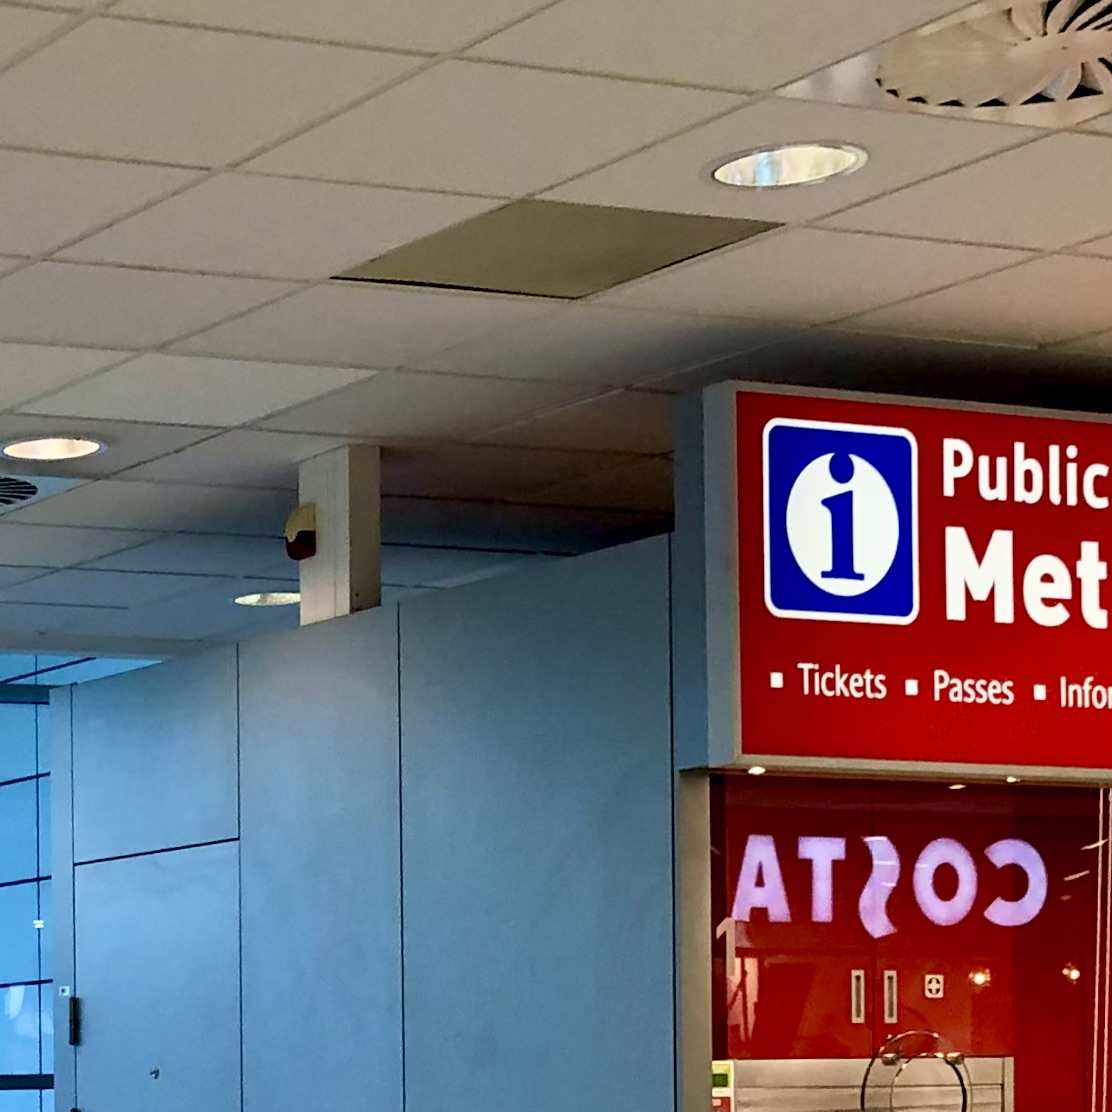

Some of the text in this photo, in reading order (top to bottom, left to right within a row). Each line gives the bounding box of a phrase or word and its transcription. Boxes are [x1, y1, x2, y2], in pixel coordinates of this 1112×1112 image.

[942, 437, 1110, 510] Public
[796, 662, 888, 700] Tickets
[933, 669, 1015, 706] Passes
